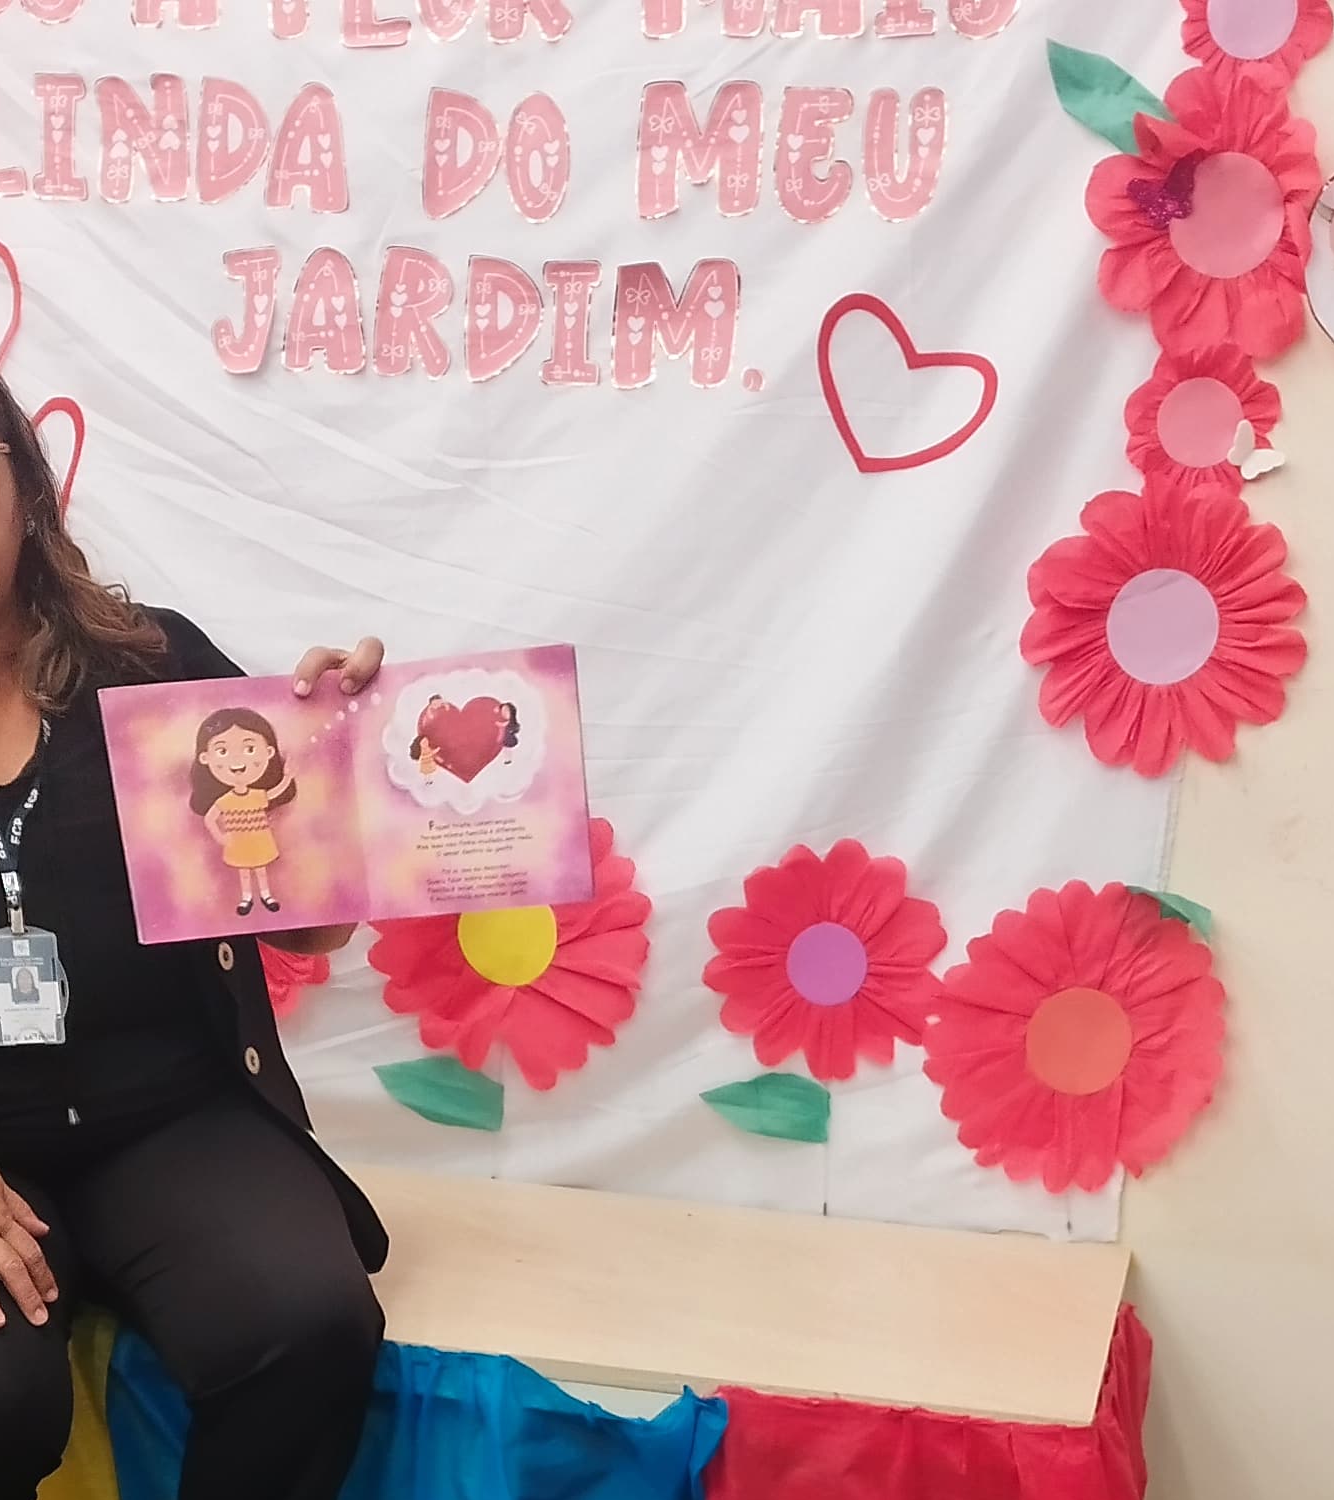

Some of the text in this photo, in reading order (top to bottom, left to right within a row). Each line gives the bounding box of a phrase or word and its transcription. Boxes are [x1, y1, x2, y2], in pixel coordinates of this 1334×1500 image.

[421, 87, 571, 223] DO
[635, 79, 952, 225] MEU
[210, 245, 765, 393] JARDIM.
[10, 817, 23, 846] FCP
